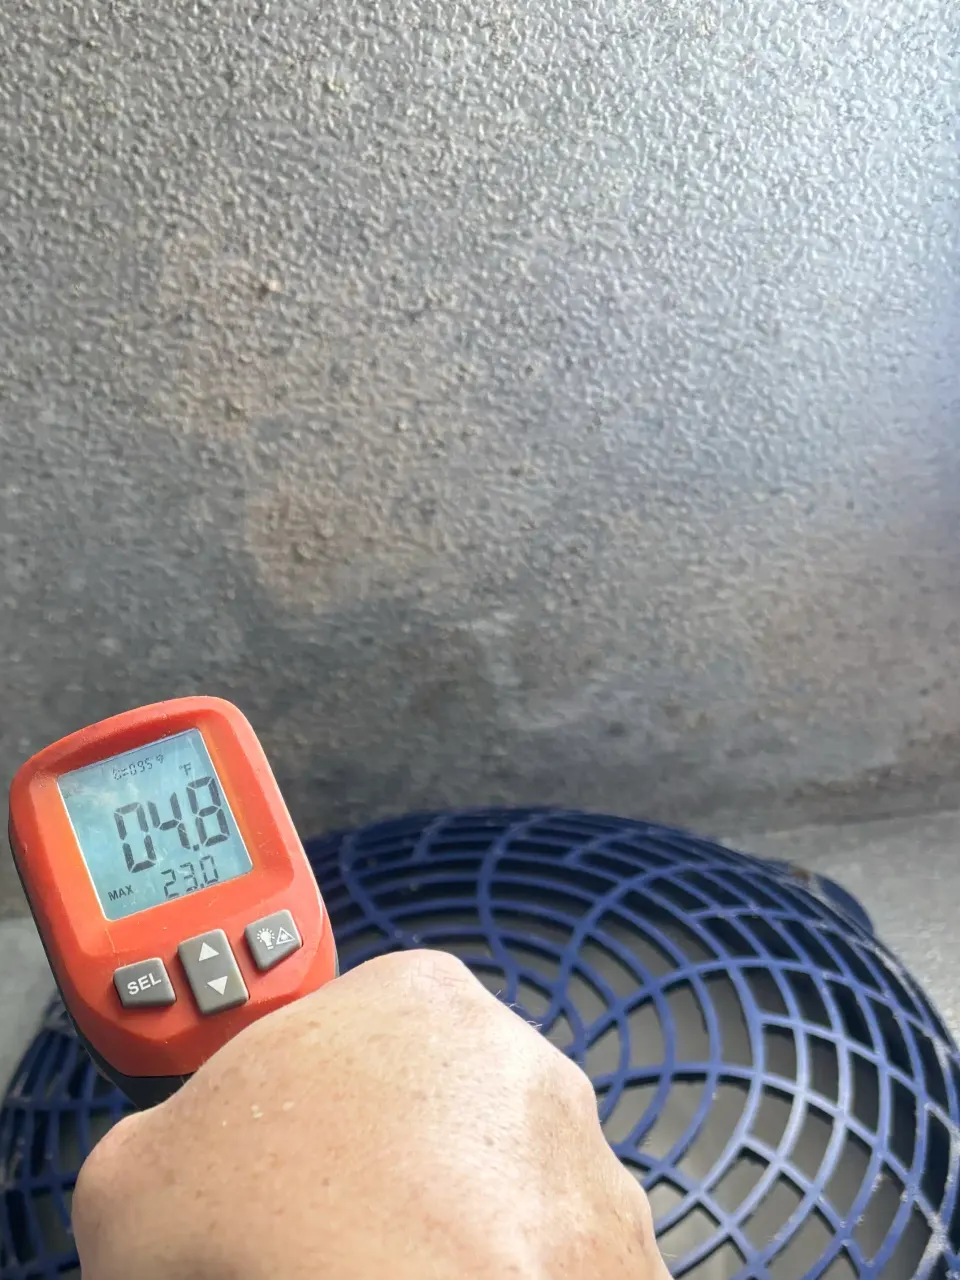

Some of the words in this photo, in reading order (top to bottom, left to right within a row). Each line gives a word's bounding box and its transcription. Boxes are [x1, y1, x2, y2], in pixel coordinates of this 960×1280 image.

[114, 776, 230, 873] 04.8
[108, 885, 134, 901] MAX
[161, 855, 219, 899] 23.0
[127, 972, 162, 996] SEL
